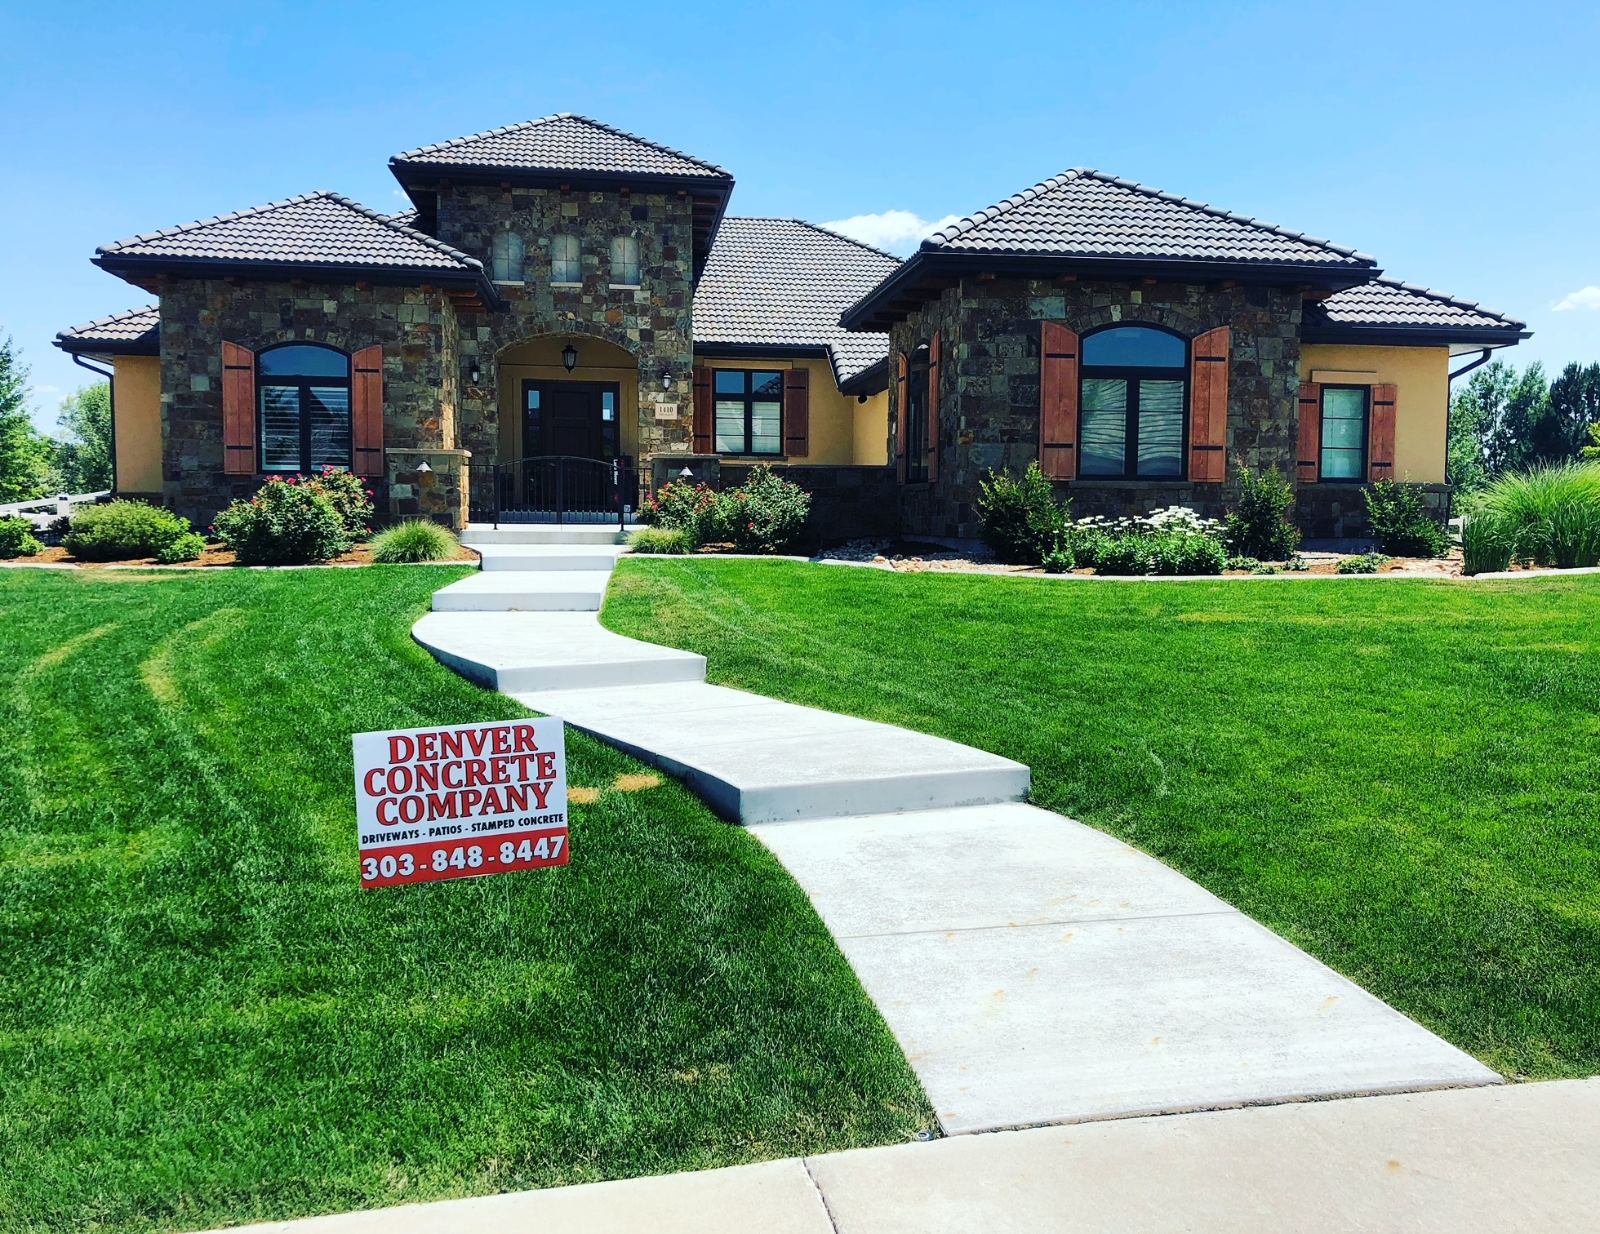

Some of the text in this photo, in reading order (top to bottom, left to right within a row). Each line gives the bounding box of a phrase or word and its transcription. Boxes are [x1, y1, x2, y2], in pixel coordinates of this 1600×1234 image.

[387, 724, 538, 765] DENVER
[363, 752, 557, 797] CONCRETE
[376, 781, 554, 826] COMPANY
[362, 829, 420, 845] DRIVEWAYS
[428, 824, 463, 837] PATIOS
[471, 819, 515, 832] STAMPED
[518, 813, 564, 827] CONCRETE
